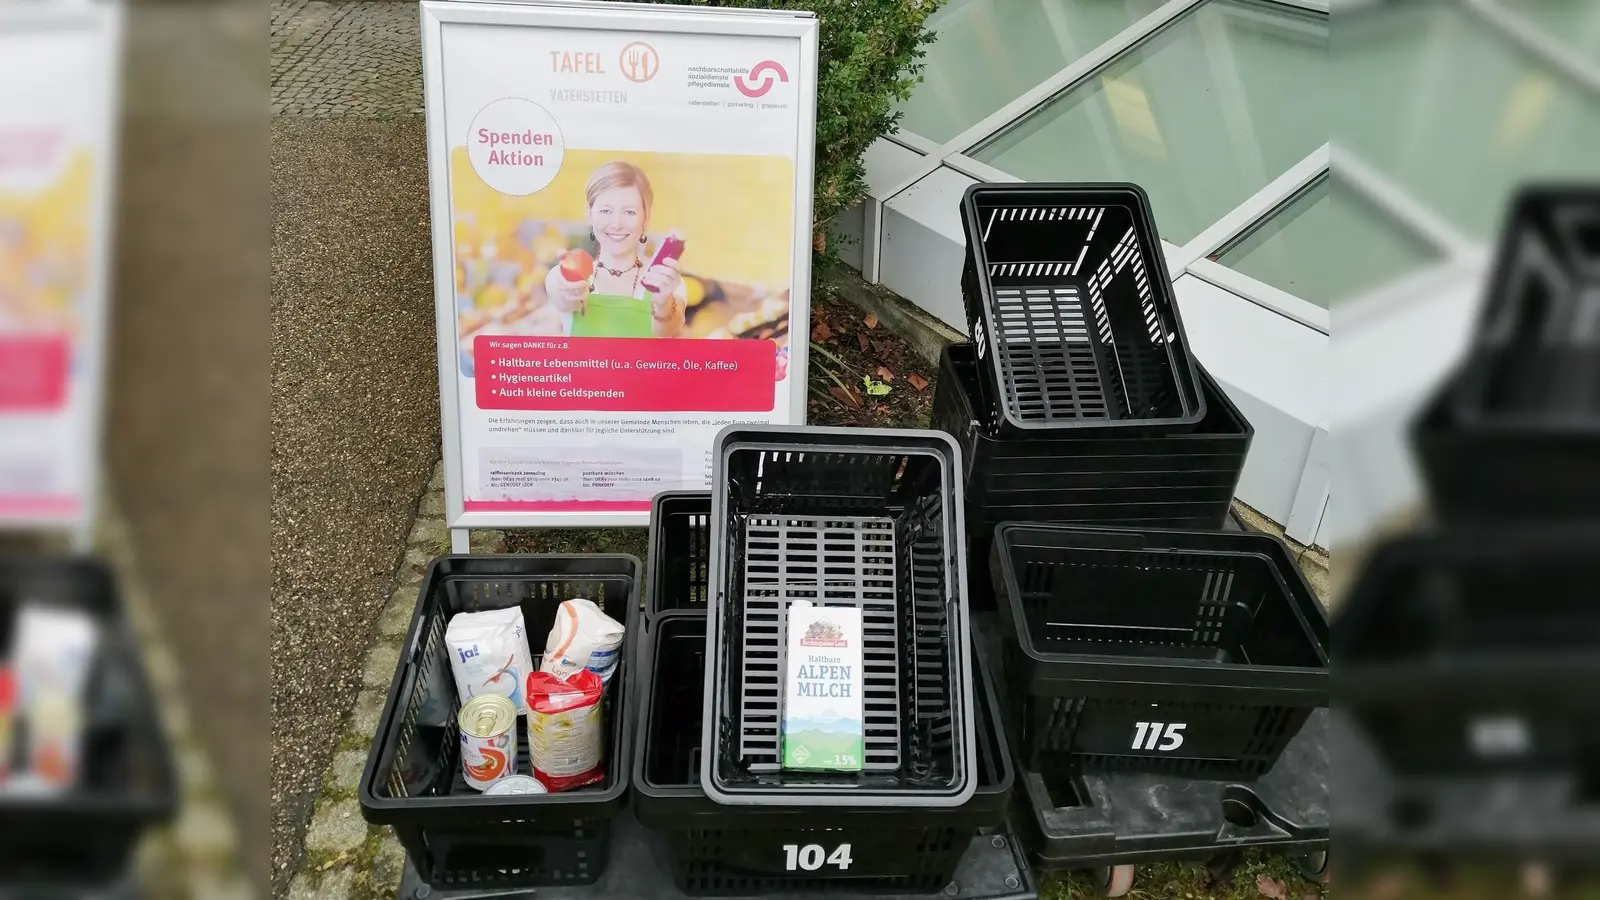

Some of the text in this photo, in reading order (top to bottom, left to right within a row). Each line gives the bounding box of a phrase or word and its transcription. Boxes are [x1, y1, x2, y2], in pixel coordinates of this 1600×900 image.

[550, 50, 606, 74] TAFEL
[687, 81, 730, 89] pflegedienste
[688, 73, 729, 81] sozialdienste
[550, 88, 627, 104] VATERSTETTEN
[478, 127, 553, 148] Spenden
[488, 149, 544, 166] Aktion
[502, 342, 522, 350] sagen
[523, 341, 546, 349] DANKE
[546, 341, 557, 349] für
[498, 357, 738, 371] Haltbare Lebensmittel (u.a. Gewürze, Öle, Kaffee)
[499, 372, 572, 384] Hygieneartikel
[500, 387, 625, 399] Auch kleine Geldspenden
[457, 643, 480, 664] ja!
[808, 655, 841, 664] Haltbare
[797, 664, 852, 680] ALPEN
[797, 681, 852, 698] MILCH
[1131, 721, 1187, 751] 115
[833, 753, 857, 767] 3,5%
[782, 843, 853, 871] 104
